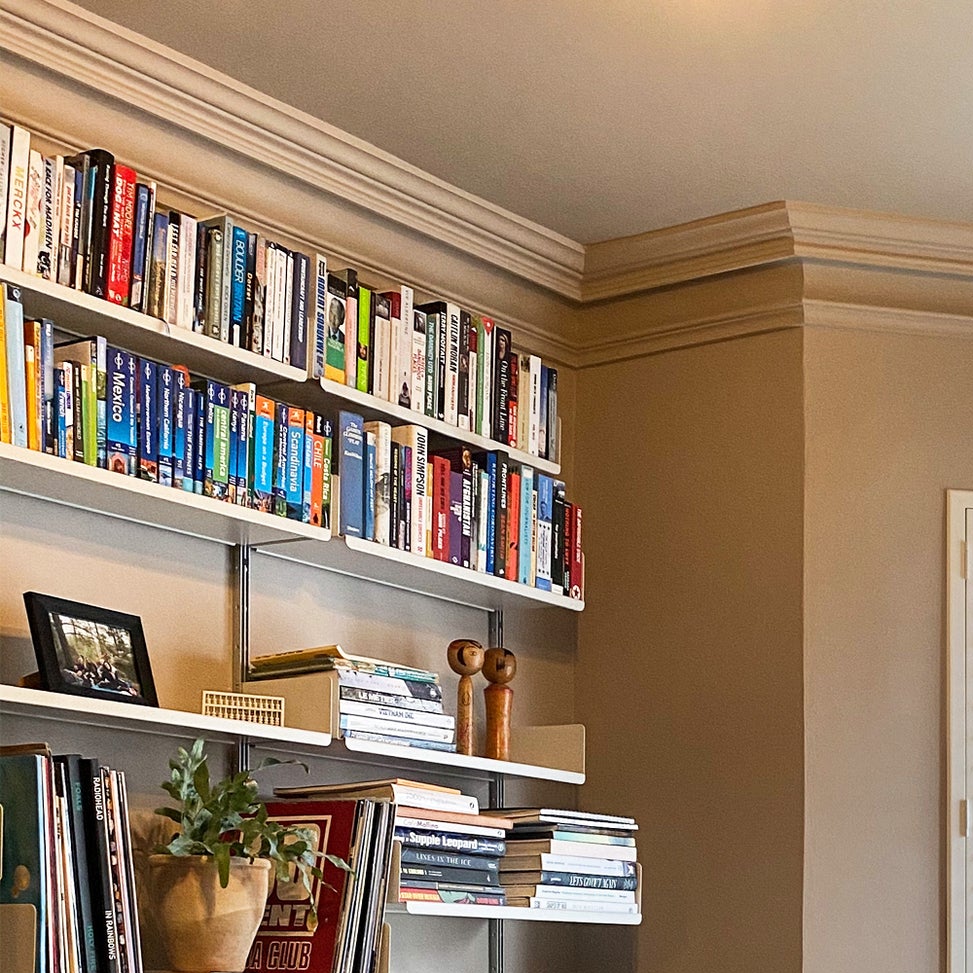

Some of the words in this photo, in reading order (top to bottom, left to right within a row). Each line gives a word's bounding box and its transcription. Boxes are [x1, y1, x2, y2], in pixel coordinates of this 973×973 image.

[44, 167, 52, 186] RACE
[114, 177, 122, 203] DOG
[126, 182, 135, 199] TIM
[12, 166, 26, 230] MERCKX
[44, 187, 52, 205] FOR
[44, 205, 53, 249] MADMEN
[112, 211, 122, 238] HAT
[124, 199, 134, 230] MOORE
[234, 239, 245, 284] BOULDER
[232, 282, 243, 322] BRITAIN
[246, 272, 254, 302] Dorset
[317, 276, 326, 311] ROBERT
[450, 314, 459, 344] CAITLIN
[449, 344, 458, 374] MORAN
[500, 360, 509, 374] On
[499, 374, 509, 388] the
[58, 390, 66, 418] French
[111, 371, 126, 423] Mexico
[144, 383, 152, 431] Mediterranean
[163, 387, 171, 418] Northern
[176, 391, 185, 429] Nicaragua
[499, 388, 508, 412] Front
[207, 402, 215, 424] Belize
[219, 409, 229, 441] central
[230, 409, 239, 433] Kenya
[239, 412, 247, 442] Panama
[498, 412, 508, 431] Line
[143, 430, 152, 455] Europe
[162, 417, 171, 450] California
[260, 420, 269, 445] Europe
[416, 432, 427, 455] JOHN
[218, 441, 228, 477] america
[261, 447, 268, 455] on
[289, 431, 301, 492] Scandinavia
[304, 436, 313, 468] Iceland
[313, 440, 322, 469] CHILE
[259, 460, 268, 486] Budget
[280, 456, 288, 489] America
[322, 457, 331, 481] Costa
[415, 456, 427, 497] SIMPSON
[321, 481, 330, 500] Rica
[500, 462, 508, 509] FRONTLINES
[461, 478, 472, 536] AFGHANISTAN
[74, 782, 83, 812] FOALS
[92, 777, 104, 821] RADIOHEAD
[409, 832, 441, 847] Supple
[441, 835, 479, 851] Leopard
[437, 854, 445, 862] IN
[446, 856, 459, 864] THE
[460, 859, 472, 867] ICE
[104, 909, 113, 919] IN
[261, 904, 311, 927] ENT
[105, 919, 117, 961] RAINBOWS
[266, 941, 313, 971] CLUB
